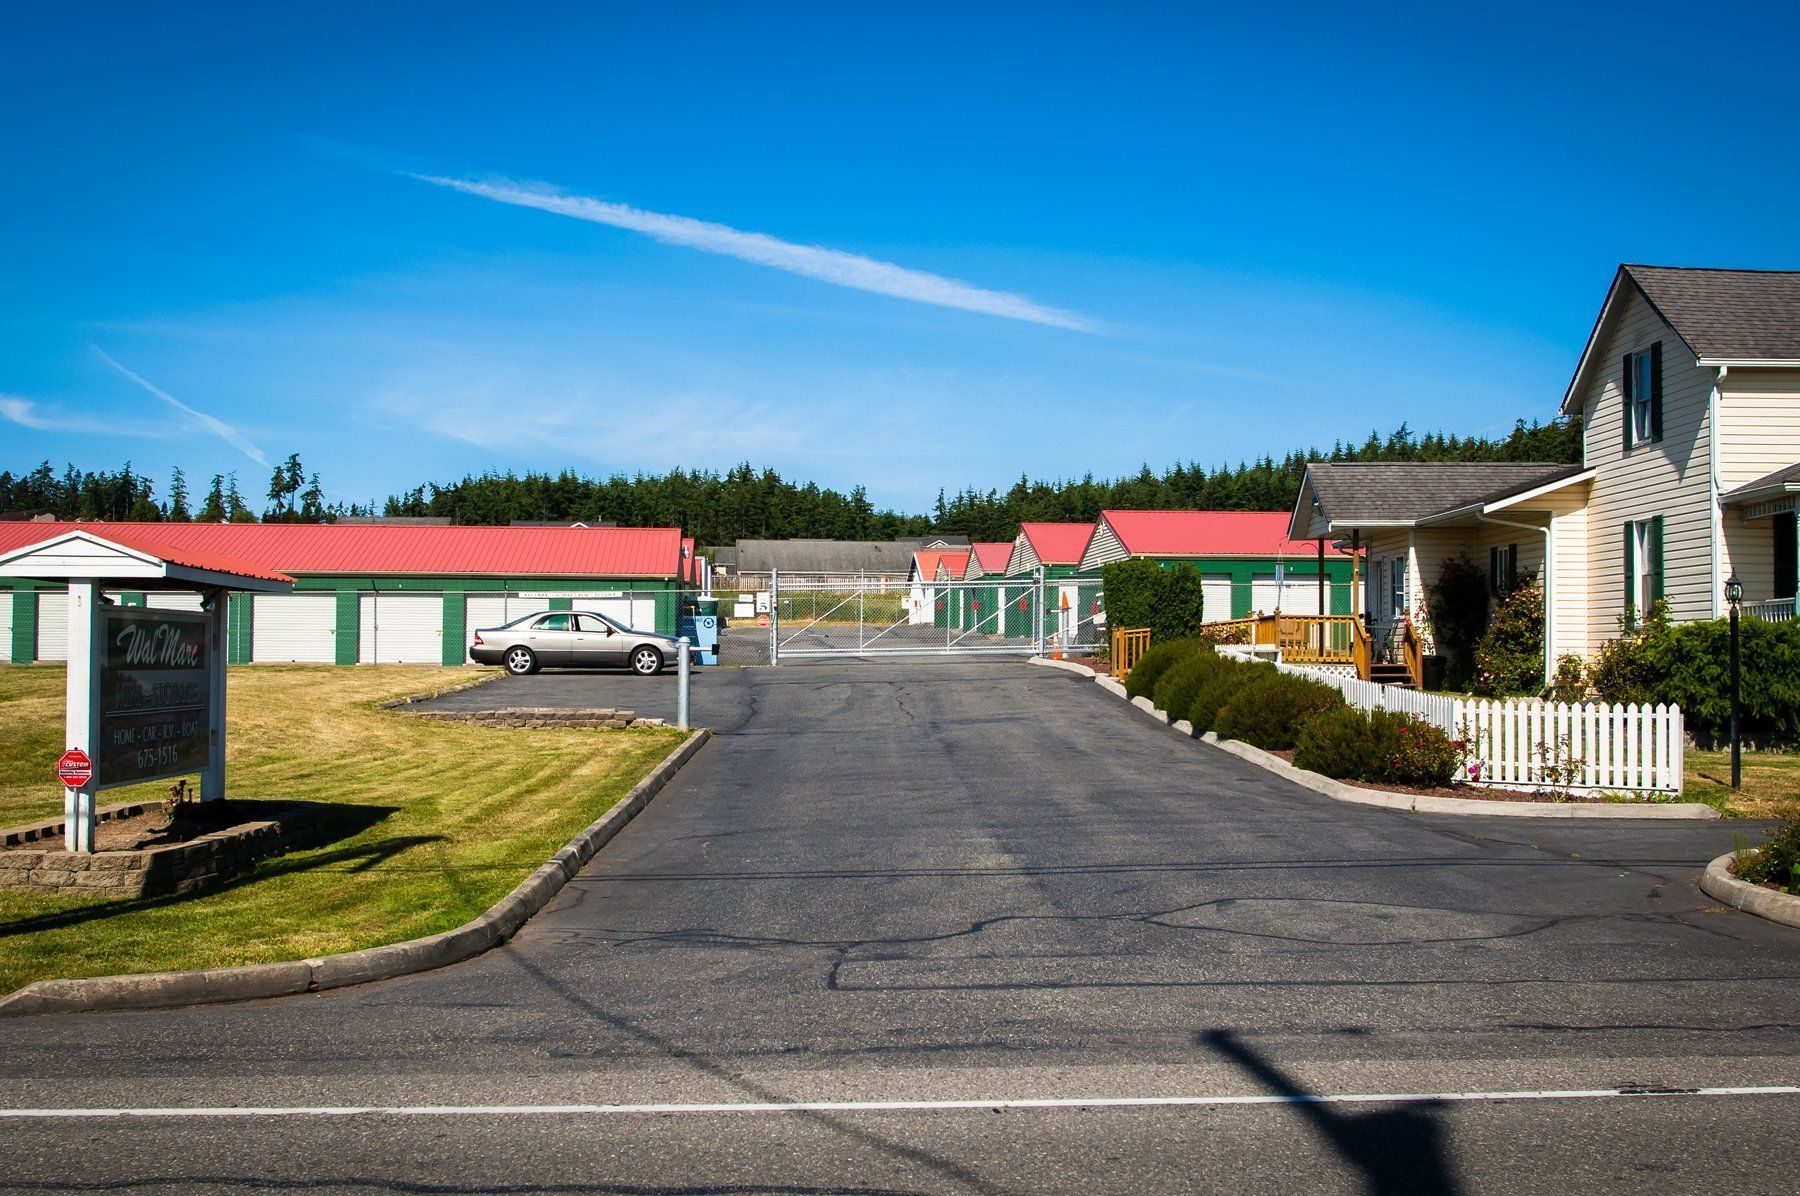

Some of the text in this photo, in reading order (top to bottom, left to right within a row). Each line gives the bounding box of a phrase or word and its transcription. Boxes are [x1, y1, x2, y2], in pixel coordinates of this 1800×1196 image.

[151, 680, 201, 706] STORAGE
[114, 728, 136, 745] HOME
[143, 726, 156, 742] CAR
[182, 721, 199, 737] BOAT
[137, 745, 178, 768] 675-1516
